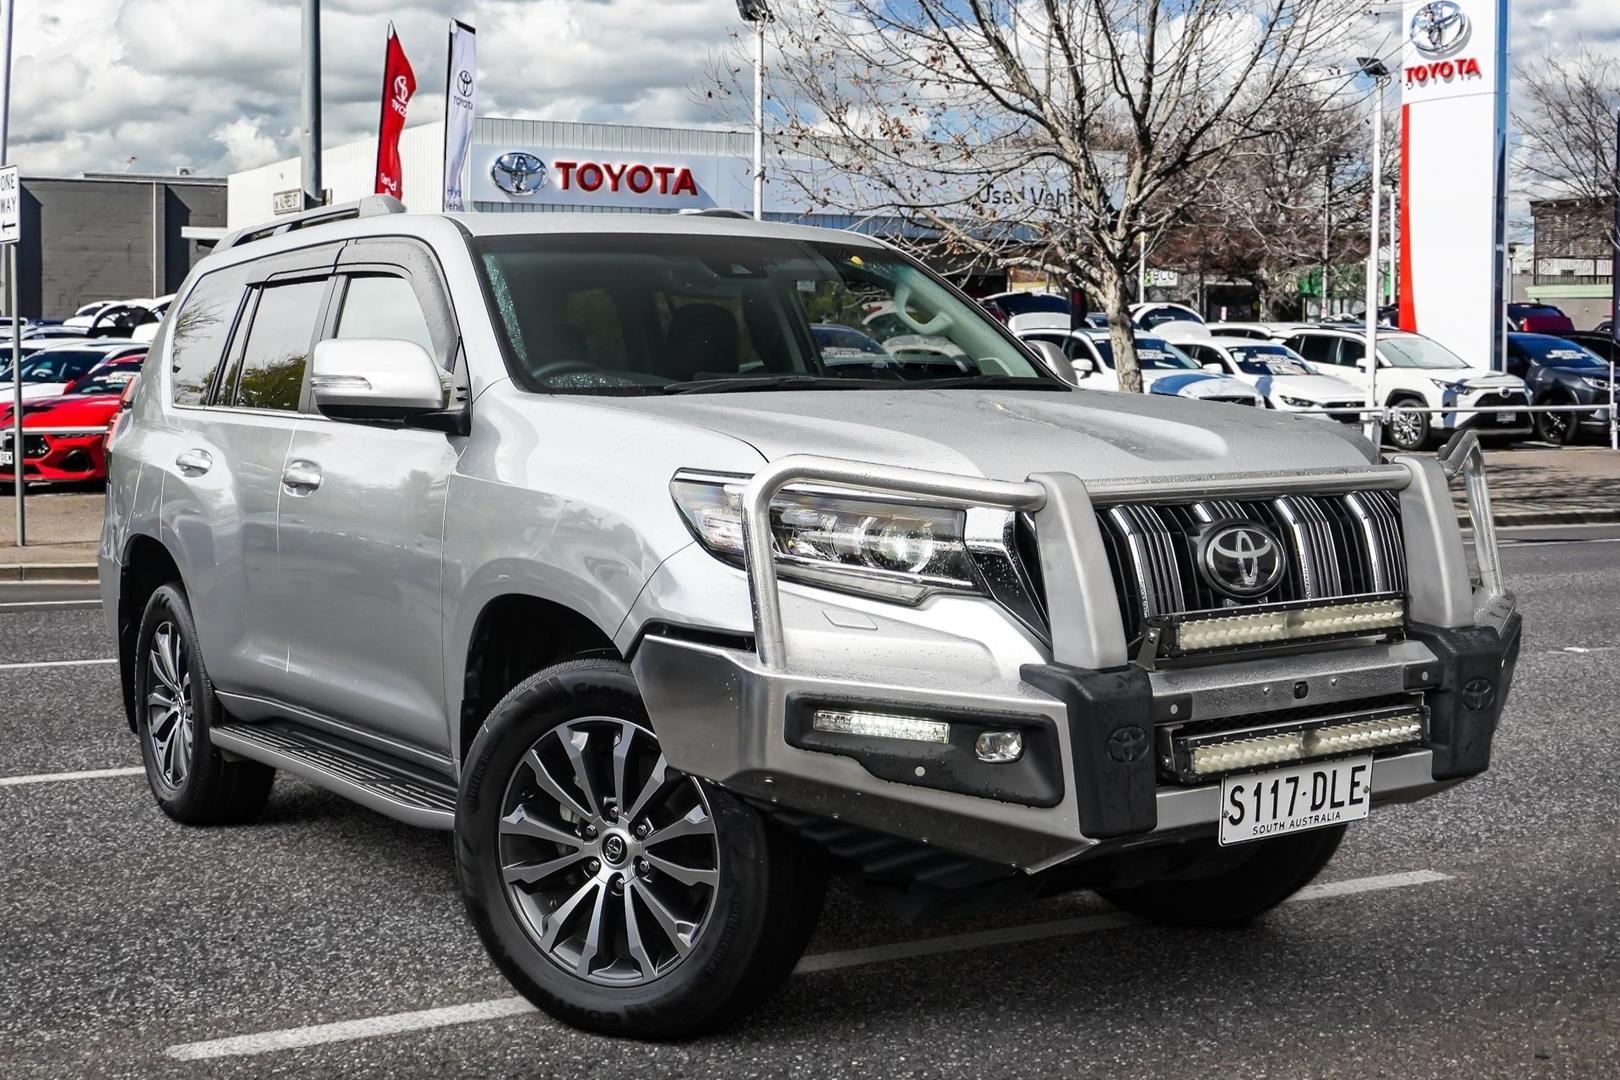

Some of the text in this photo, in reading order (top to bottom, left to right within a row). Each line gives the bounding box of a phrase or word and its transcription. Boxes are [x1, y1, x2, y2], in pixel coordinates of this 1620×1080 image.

[1404, 58, 1480, 83] TOYOTA
[0, 173, 15, 191] ONE
[555, 161, 698, 196] TOYOTA
[1252, 811, 1341, 835] SOUTH AUSTRALIA
